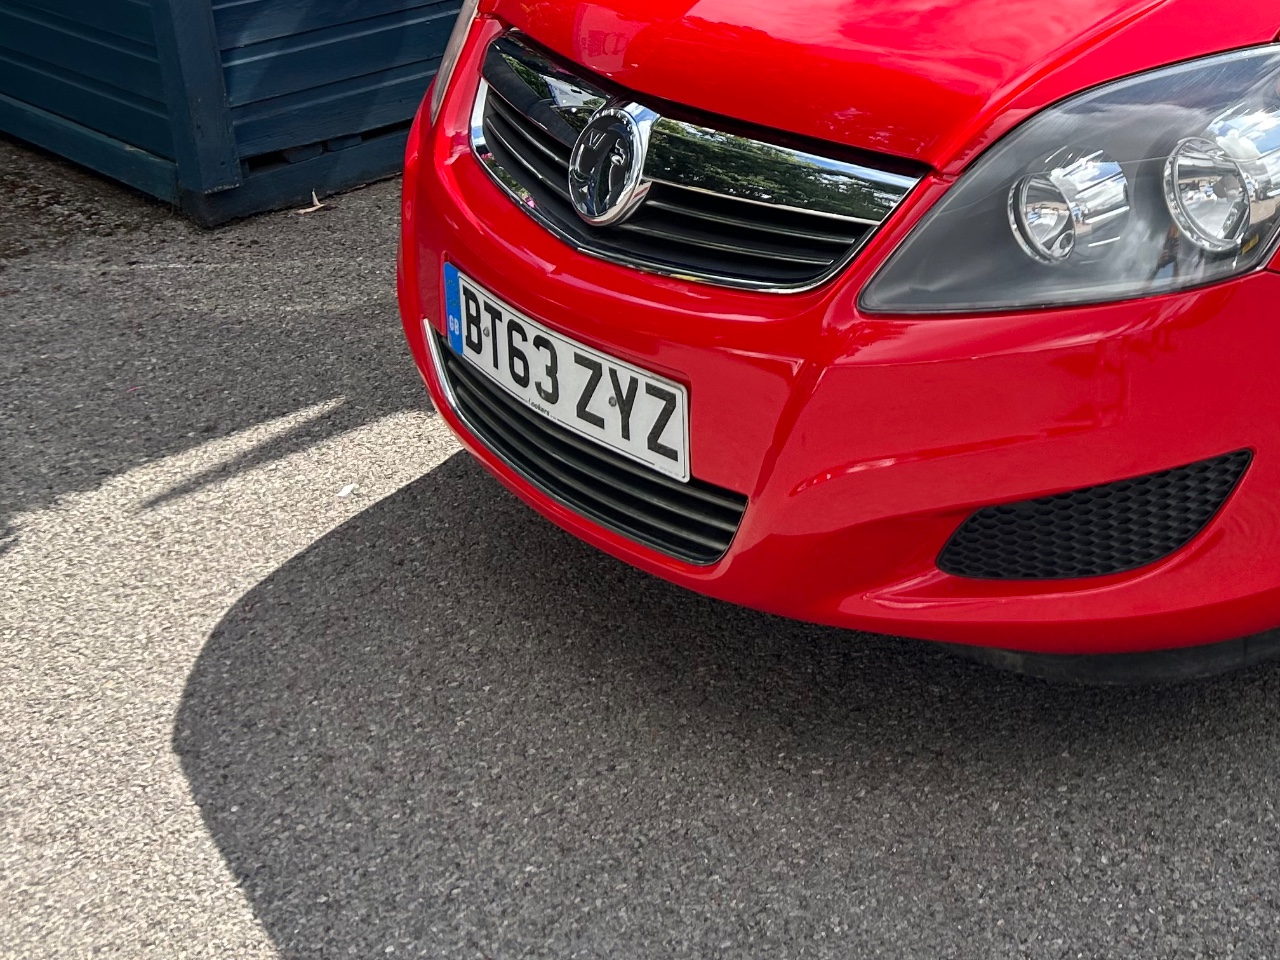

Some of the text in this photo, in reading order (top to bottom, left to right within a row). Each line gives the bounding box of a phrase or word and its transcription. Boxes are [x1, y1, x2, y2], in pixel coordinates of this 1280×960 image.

[448, 314, 460, 336] GB
[462, 284, 679, 463] BT63 ZYZ
